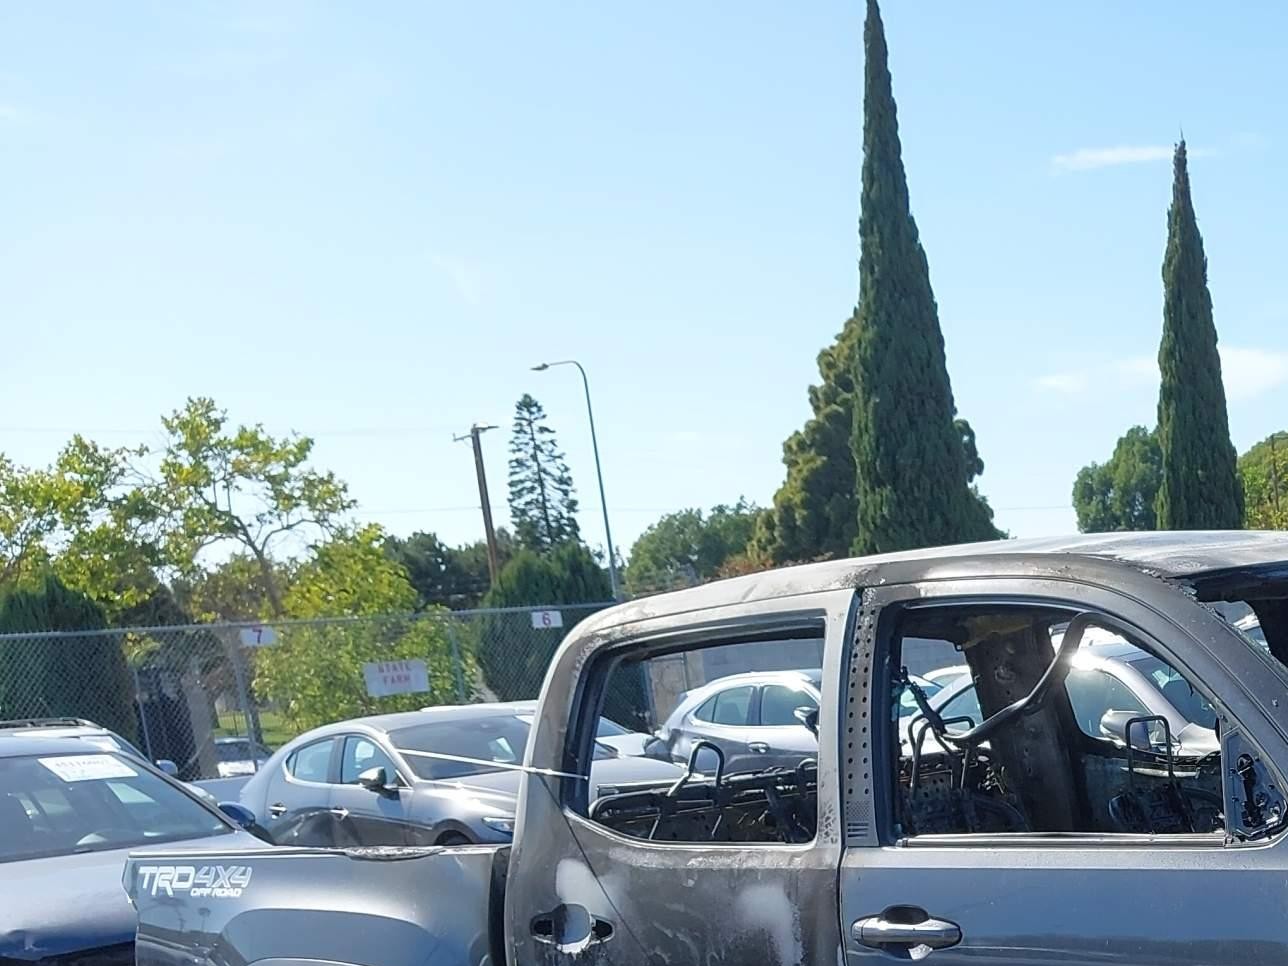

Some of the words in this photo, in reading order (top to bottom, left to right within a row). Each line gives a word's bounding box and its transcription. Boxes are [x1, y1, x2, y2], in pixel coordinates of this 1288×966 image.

[542, 611, 552, 626] 6
[252, 627, 262, 644] 7
[190, 887, 213, 897] OFF
[211, 887, 242, 897] ROAD
